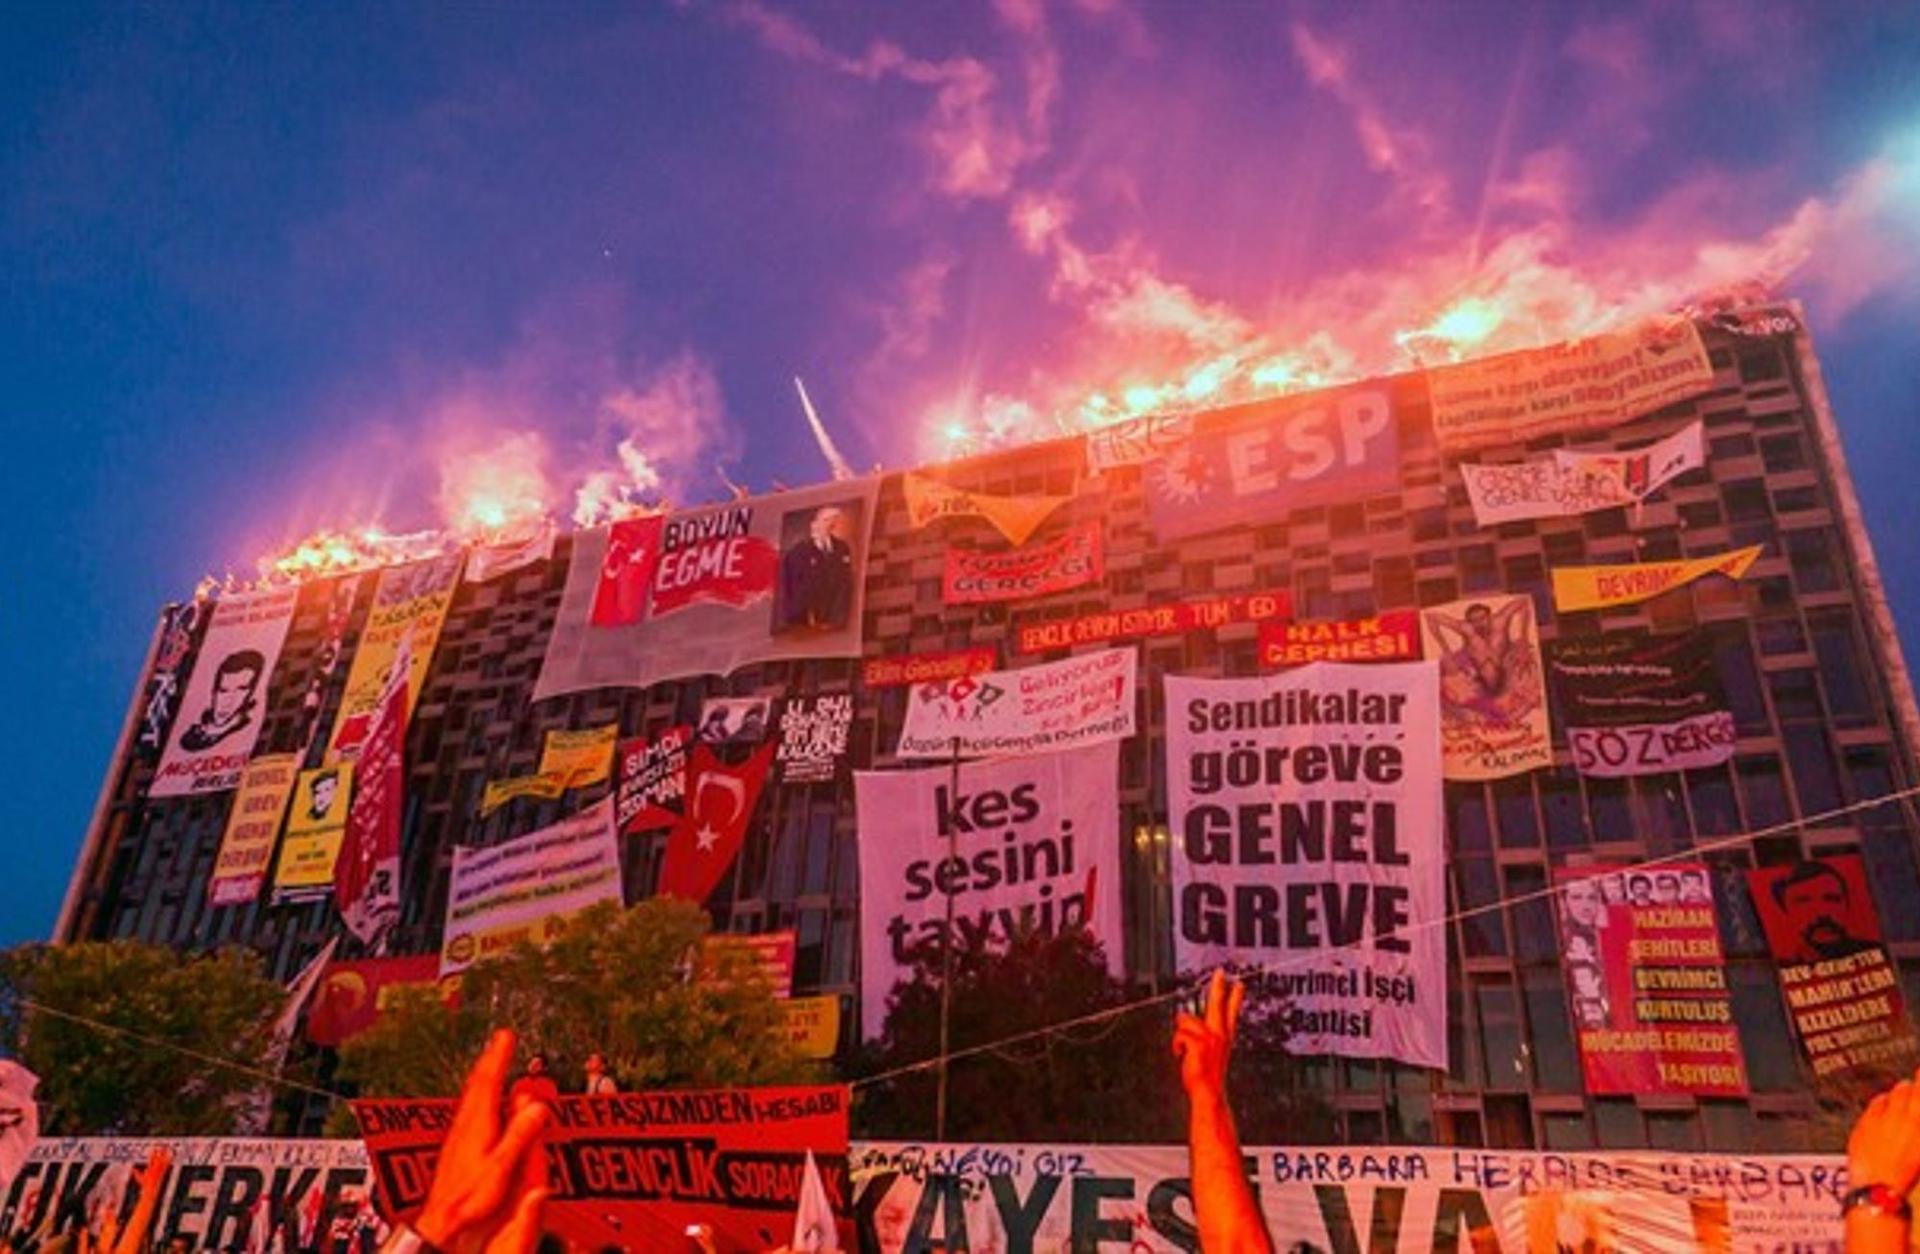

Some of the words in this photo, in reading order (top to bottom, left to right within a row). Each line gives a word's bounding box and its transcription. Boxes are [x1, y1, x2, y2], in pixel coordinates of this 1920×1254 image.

[1227, 391, 1390, 495] ESP
[1286, 616, 1382, 643] HALK
[1188, 689, 1406, 733] Sendikalar
[935, 783, 1040, 836] kes
[1184, 803, 1411, 866] GENEL
[905, 819, 1074, 900] sesini
[1181, 883, 1412, 953] GREVE
[755, 1092, 839, 1123] HESABI
[1273, 1152, 1430, 1183] BARBARA
